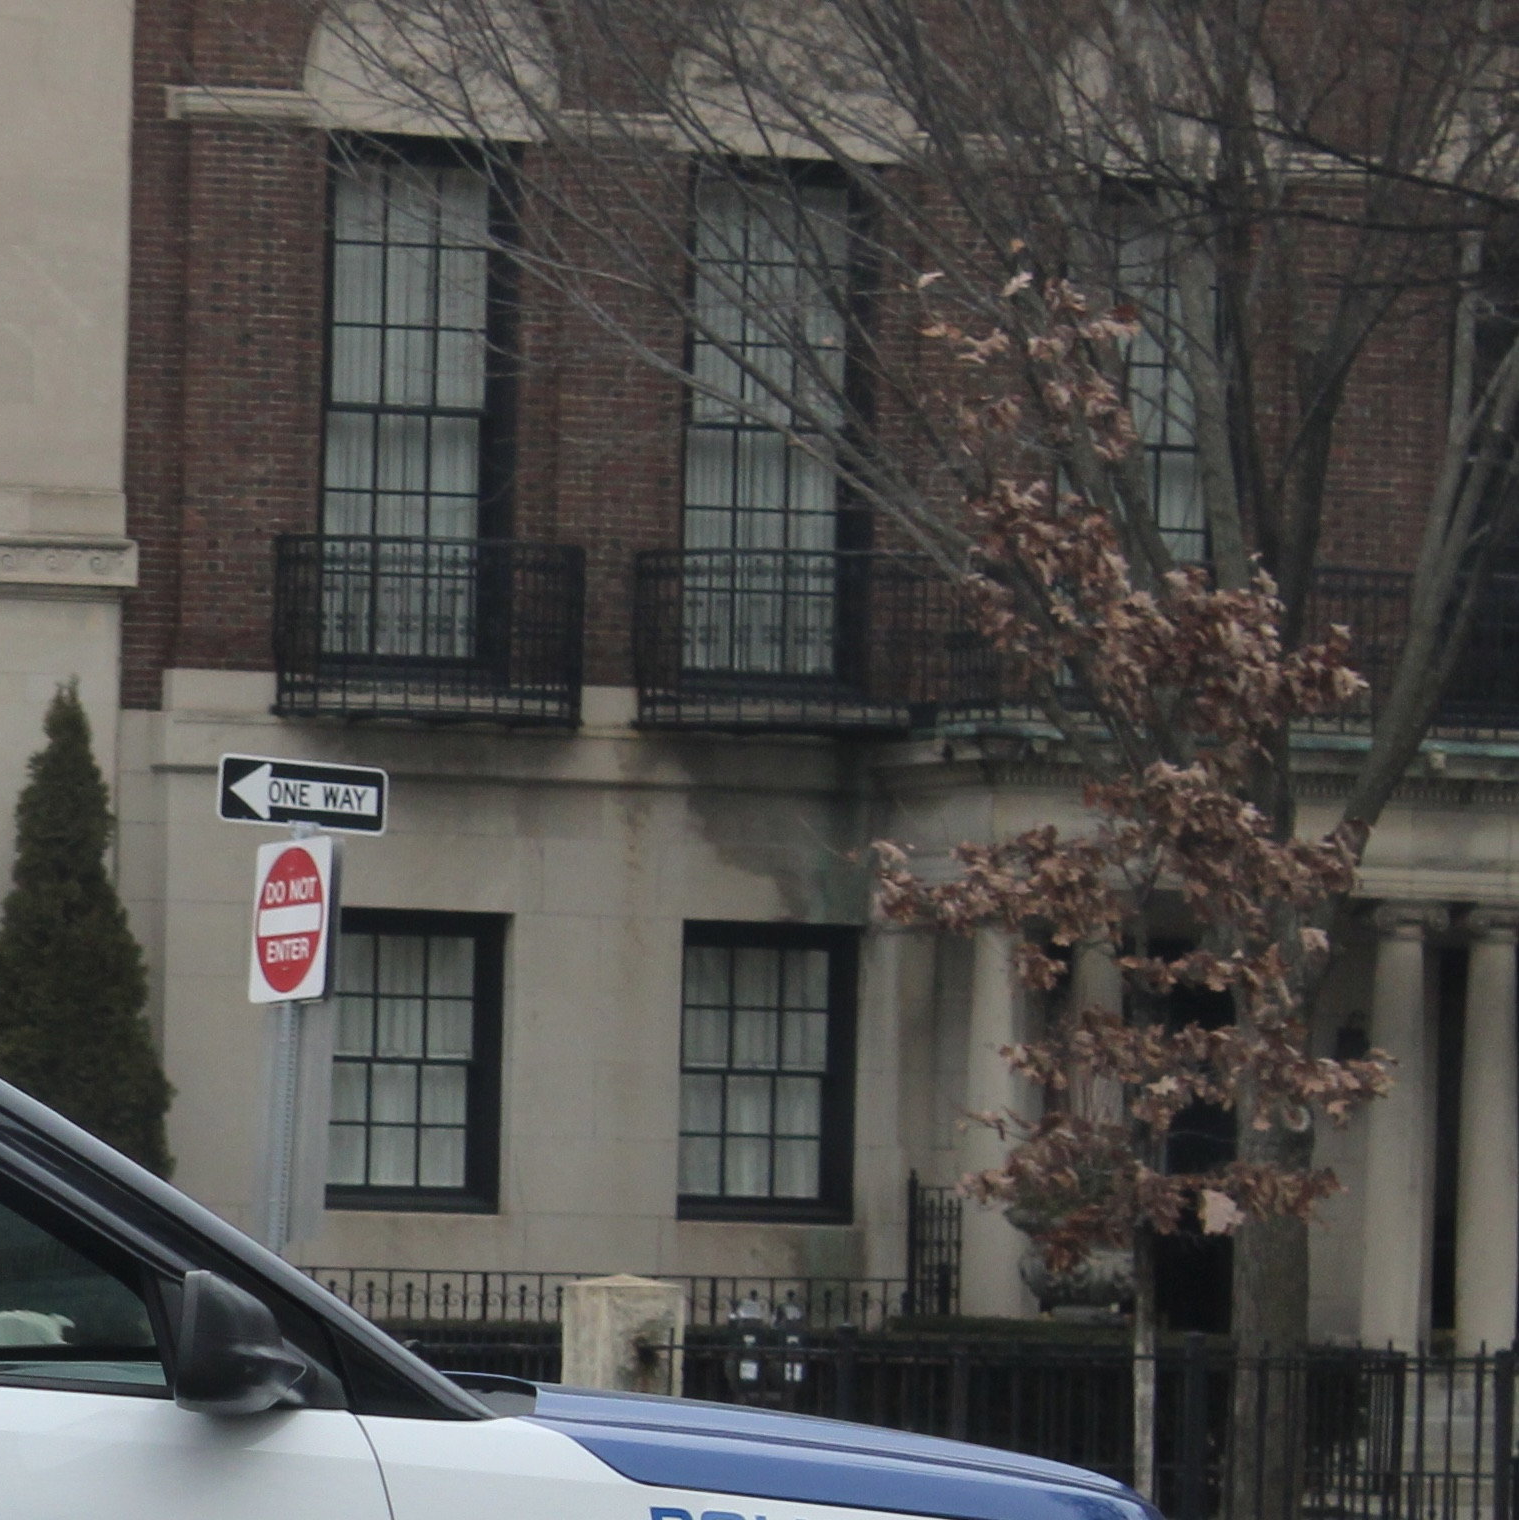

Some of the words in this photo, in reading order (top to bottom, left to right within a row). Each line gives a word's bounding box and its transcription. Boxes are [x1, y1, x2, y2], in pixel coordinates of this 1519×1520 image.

[268, 780, 310, 807] ONE
[322, 786, 368, 812] WAY
[265, 880, 286, 904] DO
[289, 877, 317, 900] NOT
[266, 937, 310, 964] ENTER
